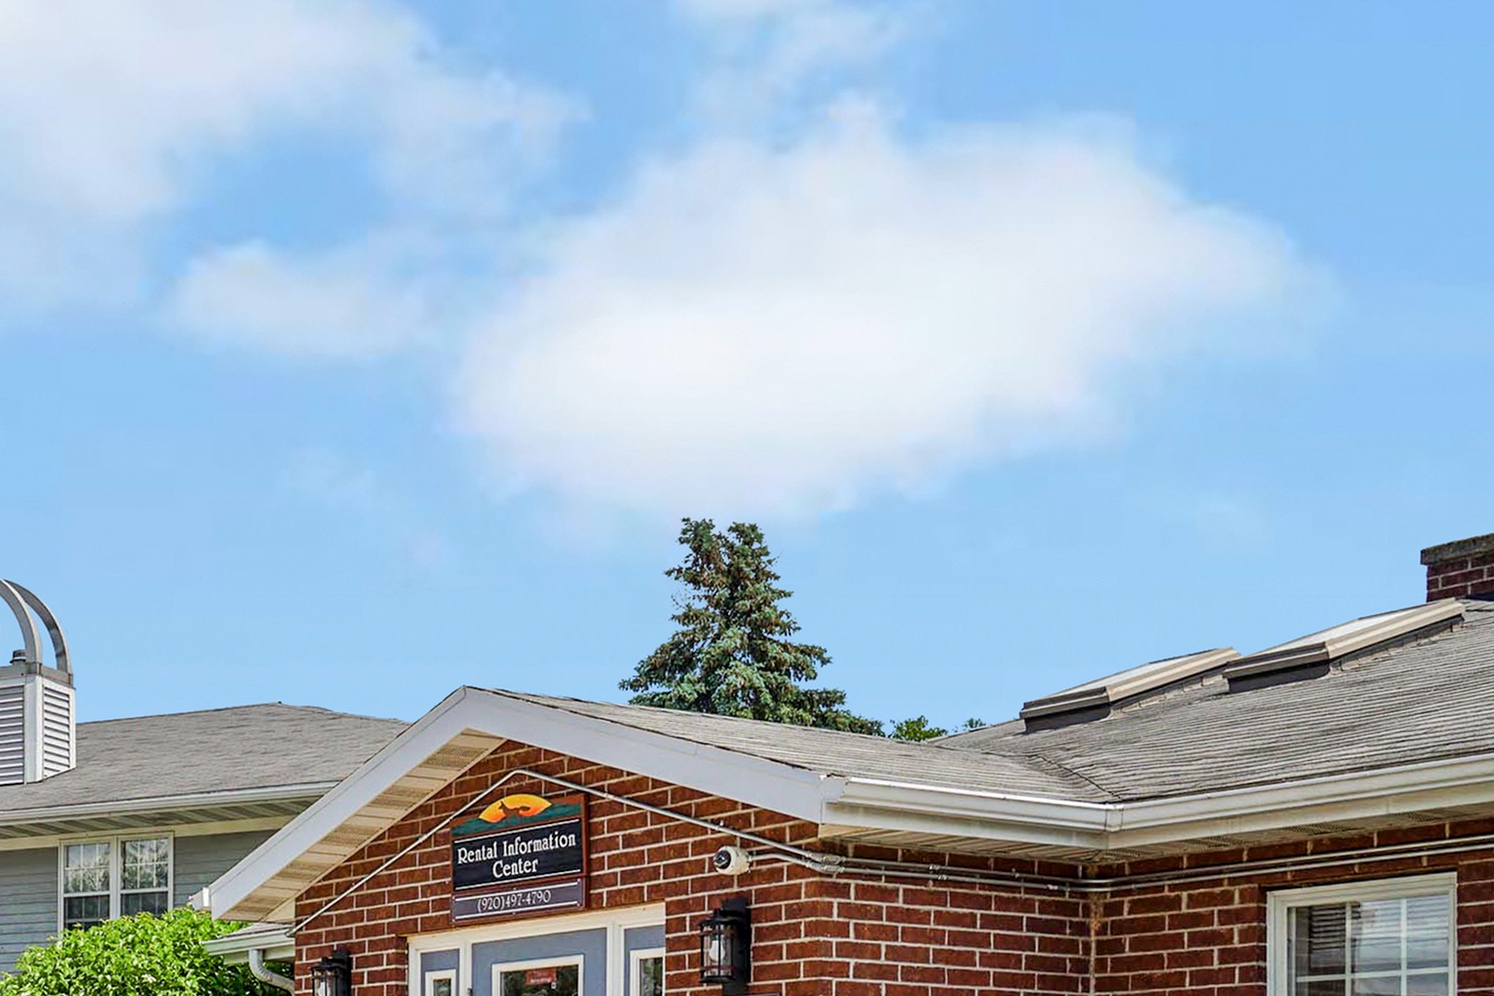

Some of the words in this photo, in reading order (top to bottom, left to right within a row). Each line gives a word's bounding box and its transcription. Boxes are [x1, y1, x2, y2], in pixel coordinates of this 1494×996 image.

[457, 841, 498, 864] Rental
[502, 831, 576, 857] Information
[492, 858, 539, 879] Center
[477, 890, 552, 913] (920)497-4790
